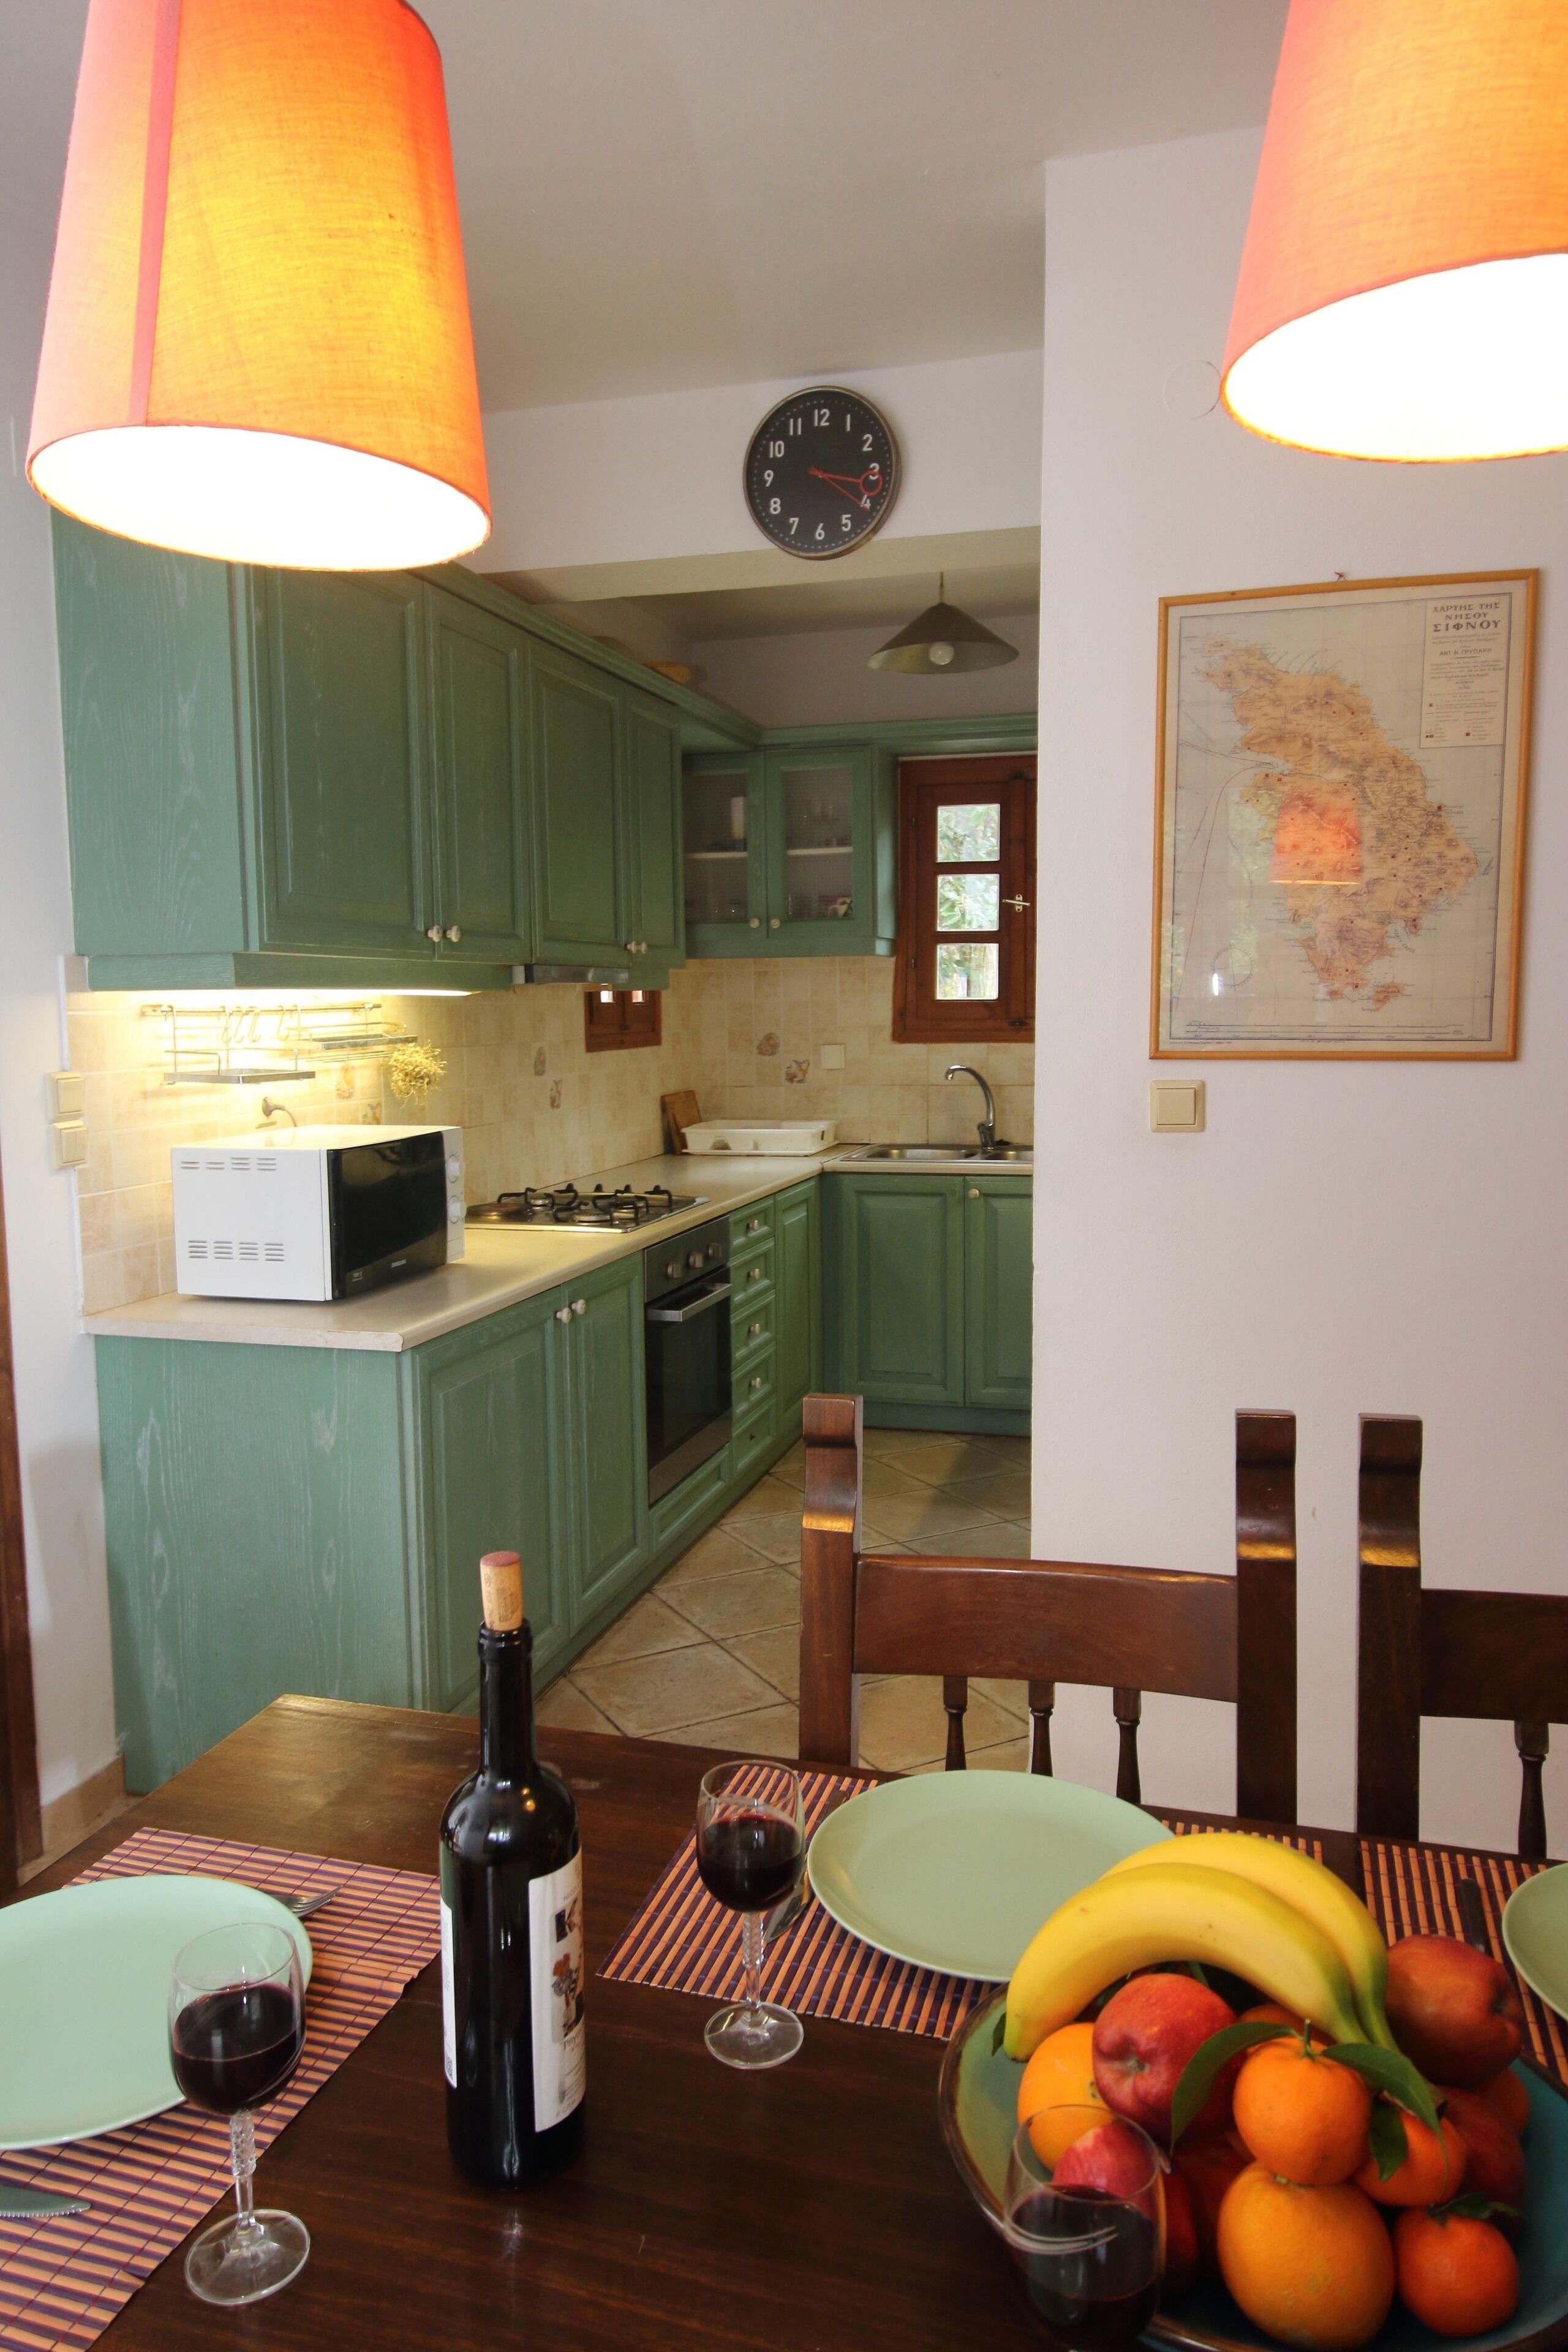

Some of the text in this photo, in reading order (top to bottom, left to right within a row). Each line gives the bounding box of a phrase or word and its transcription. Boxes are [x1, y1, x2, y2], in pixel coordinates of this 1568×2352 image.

[790, 418, 802, 435] 11
[813, 409, 830, 427] 12
[846, 414, 851, 431] 1
[769, 440, 785, 458] 10
[862, 434, 873, 451] 2
[764, 470, 774, 487] 9
[869, 462, 880, 480] 3
[770, 497, 781, 514] 8
[790, 518, 799, 535] 7
[815, 523, 824, 540] 6
[842, 514, 851, 532] 5
[1433, 604, 1474, 612] ΧΑΡΤΗΣ
[1446, 612, 1488, 620] ΝΗΣΟΥ
[1433, 619, 1501, 633] ΣΙΦΝΟΥ
